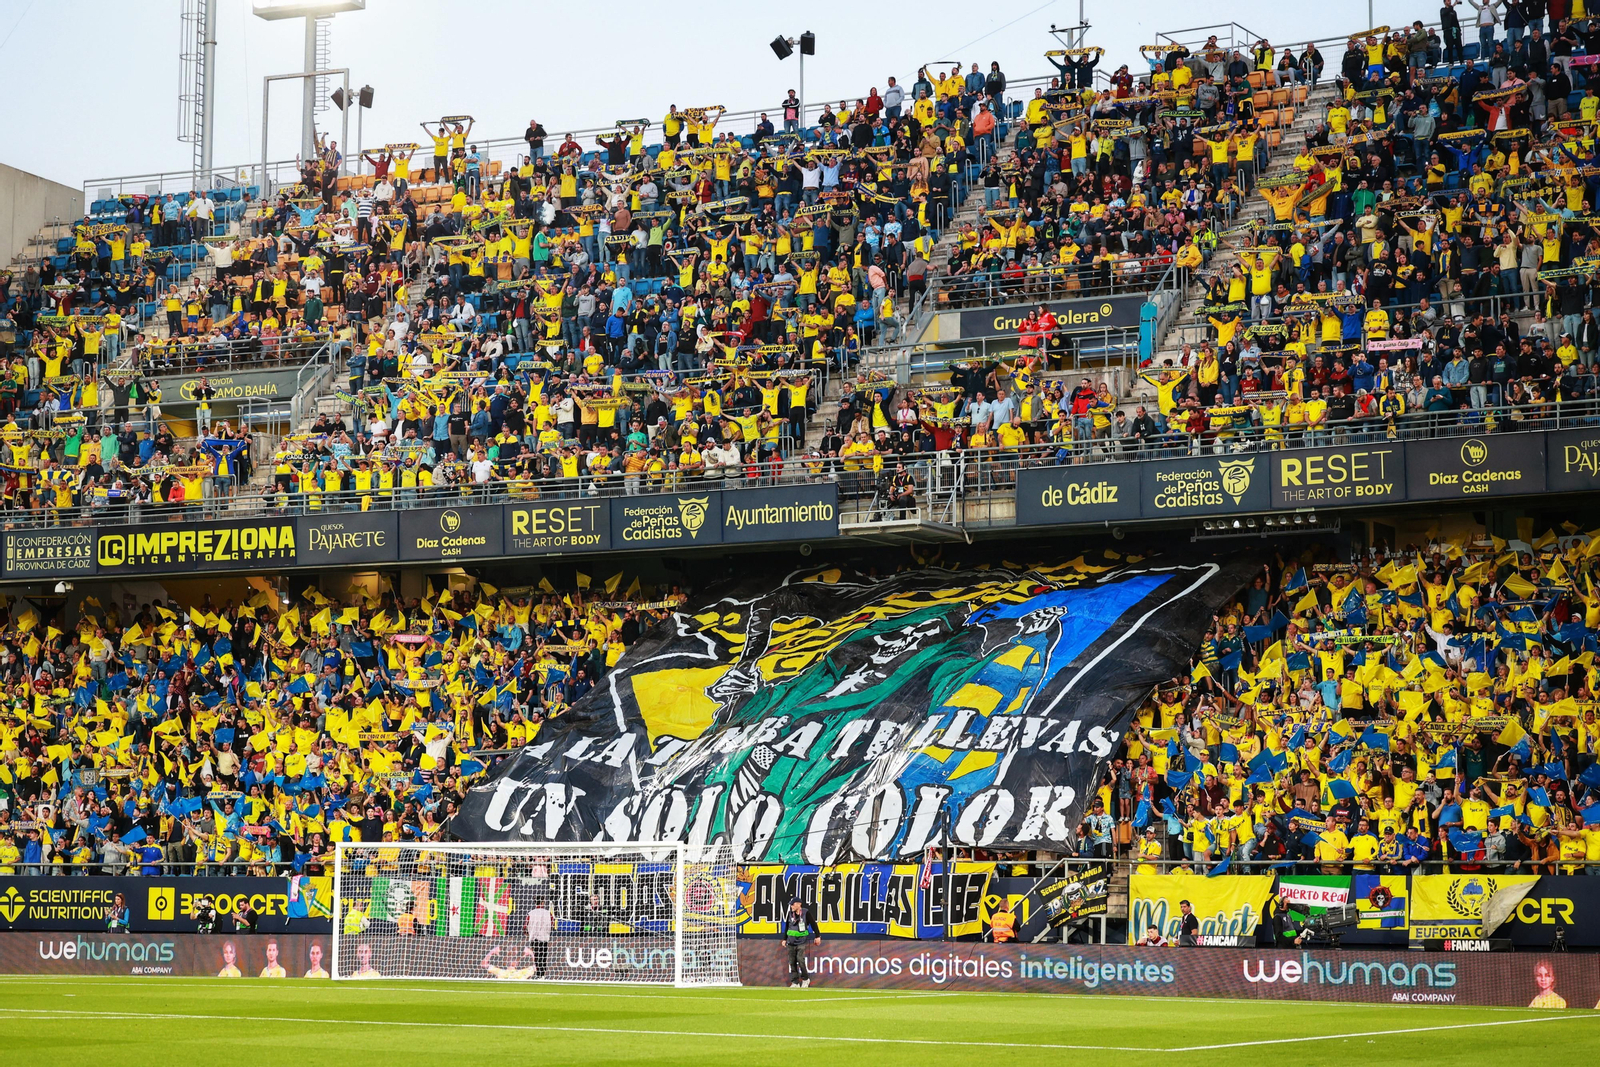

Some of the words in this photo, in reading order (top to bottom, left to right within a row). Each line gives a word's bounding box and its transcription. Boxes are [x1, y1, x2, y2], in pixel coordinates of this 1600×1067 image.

[802, 205, 826, 214] CADIZ
[209, 378, 233, 386] TOYOTA
[245, 382, 277, 396] BAHÍA
[1281, 450, 1392, 486] RESET
[1156, 469, 1212, 482] Federación
[1429, 472, 1459, 485] Díaz
[1462, 469, 1522, 482] Cadenas
[1164, 484, 1177, 494] de
[1178, 480, 1219, 494] Peñas
[1282, 490, 1305, 502] THE
[1308, 488, 1332, 500] ART
[1334, 486, 1351, 498] OF
[1356, 484, 1392, 497] BODY
[1462, 484, 1489, 493] CASH
[1042, 485, 1062, 507] de
[1067, 481, 1118, 506] Cádiz
[1154, 492, 1223, 508] Cadistas
[624, 506, 672, 516] Federación
[726, 501, 833, 530] Ayuntamiento
[512, 506, 600, 535] RESET
[631, 519, 642, 528] de
[642, 515, 678, 528] Peñas
[623, 525, 682, 541] Cadistas
[16, 533, 92, 547] CONFEDERACIÓN
[128, 526, 295, 561] IMPREZIONA
[416, 538, 438, 548] Díaz
[441, 535, 486, 546] Cadenas
[513, 538, 531, 548] THE
[533, 537, 553, 548] ART
[554, 536, 568, 546] OF
[570, 535, 600, 546] BODY
[17, 546, 91, 559] EMPRESAS
[16, 560, 54, 571] PROVINCIA
[56, 560, 66, 569] DE
[67, 558, 90, 568] CÁDIZ
[1069, 875, 1078, 884] LA
[29, 890, 113, 903] SCIENTIFFIC
[752, 872, 918, 927] AMARILLAS
[920, 872, 988, 926] 1982
[29, 906, 103, 919] NUTRITION
[1416, 927, 1472, 938] EUFORIA
[1197, 936, 1238, 946] #FANCAM
[1444, 940, 1490, 951] #FANCAM
[40, 935, 175, 962] wehumans
[144, 966, 172, 974] COMPANY
[788, 956, 902, 974] umanos
[909, 953, 1012, 984] digitales
[1020, 954, 1174, 988] inteligentes
[1243, 952, 1456, 987] wehumans
[1412, 994, 1456, 1002] COMPANY
